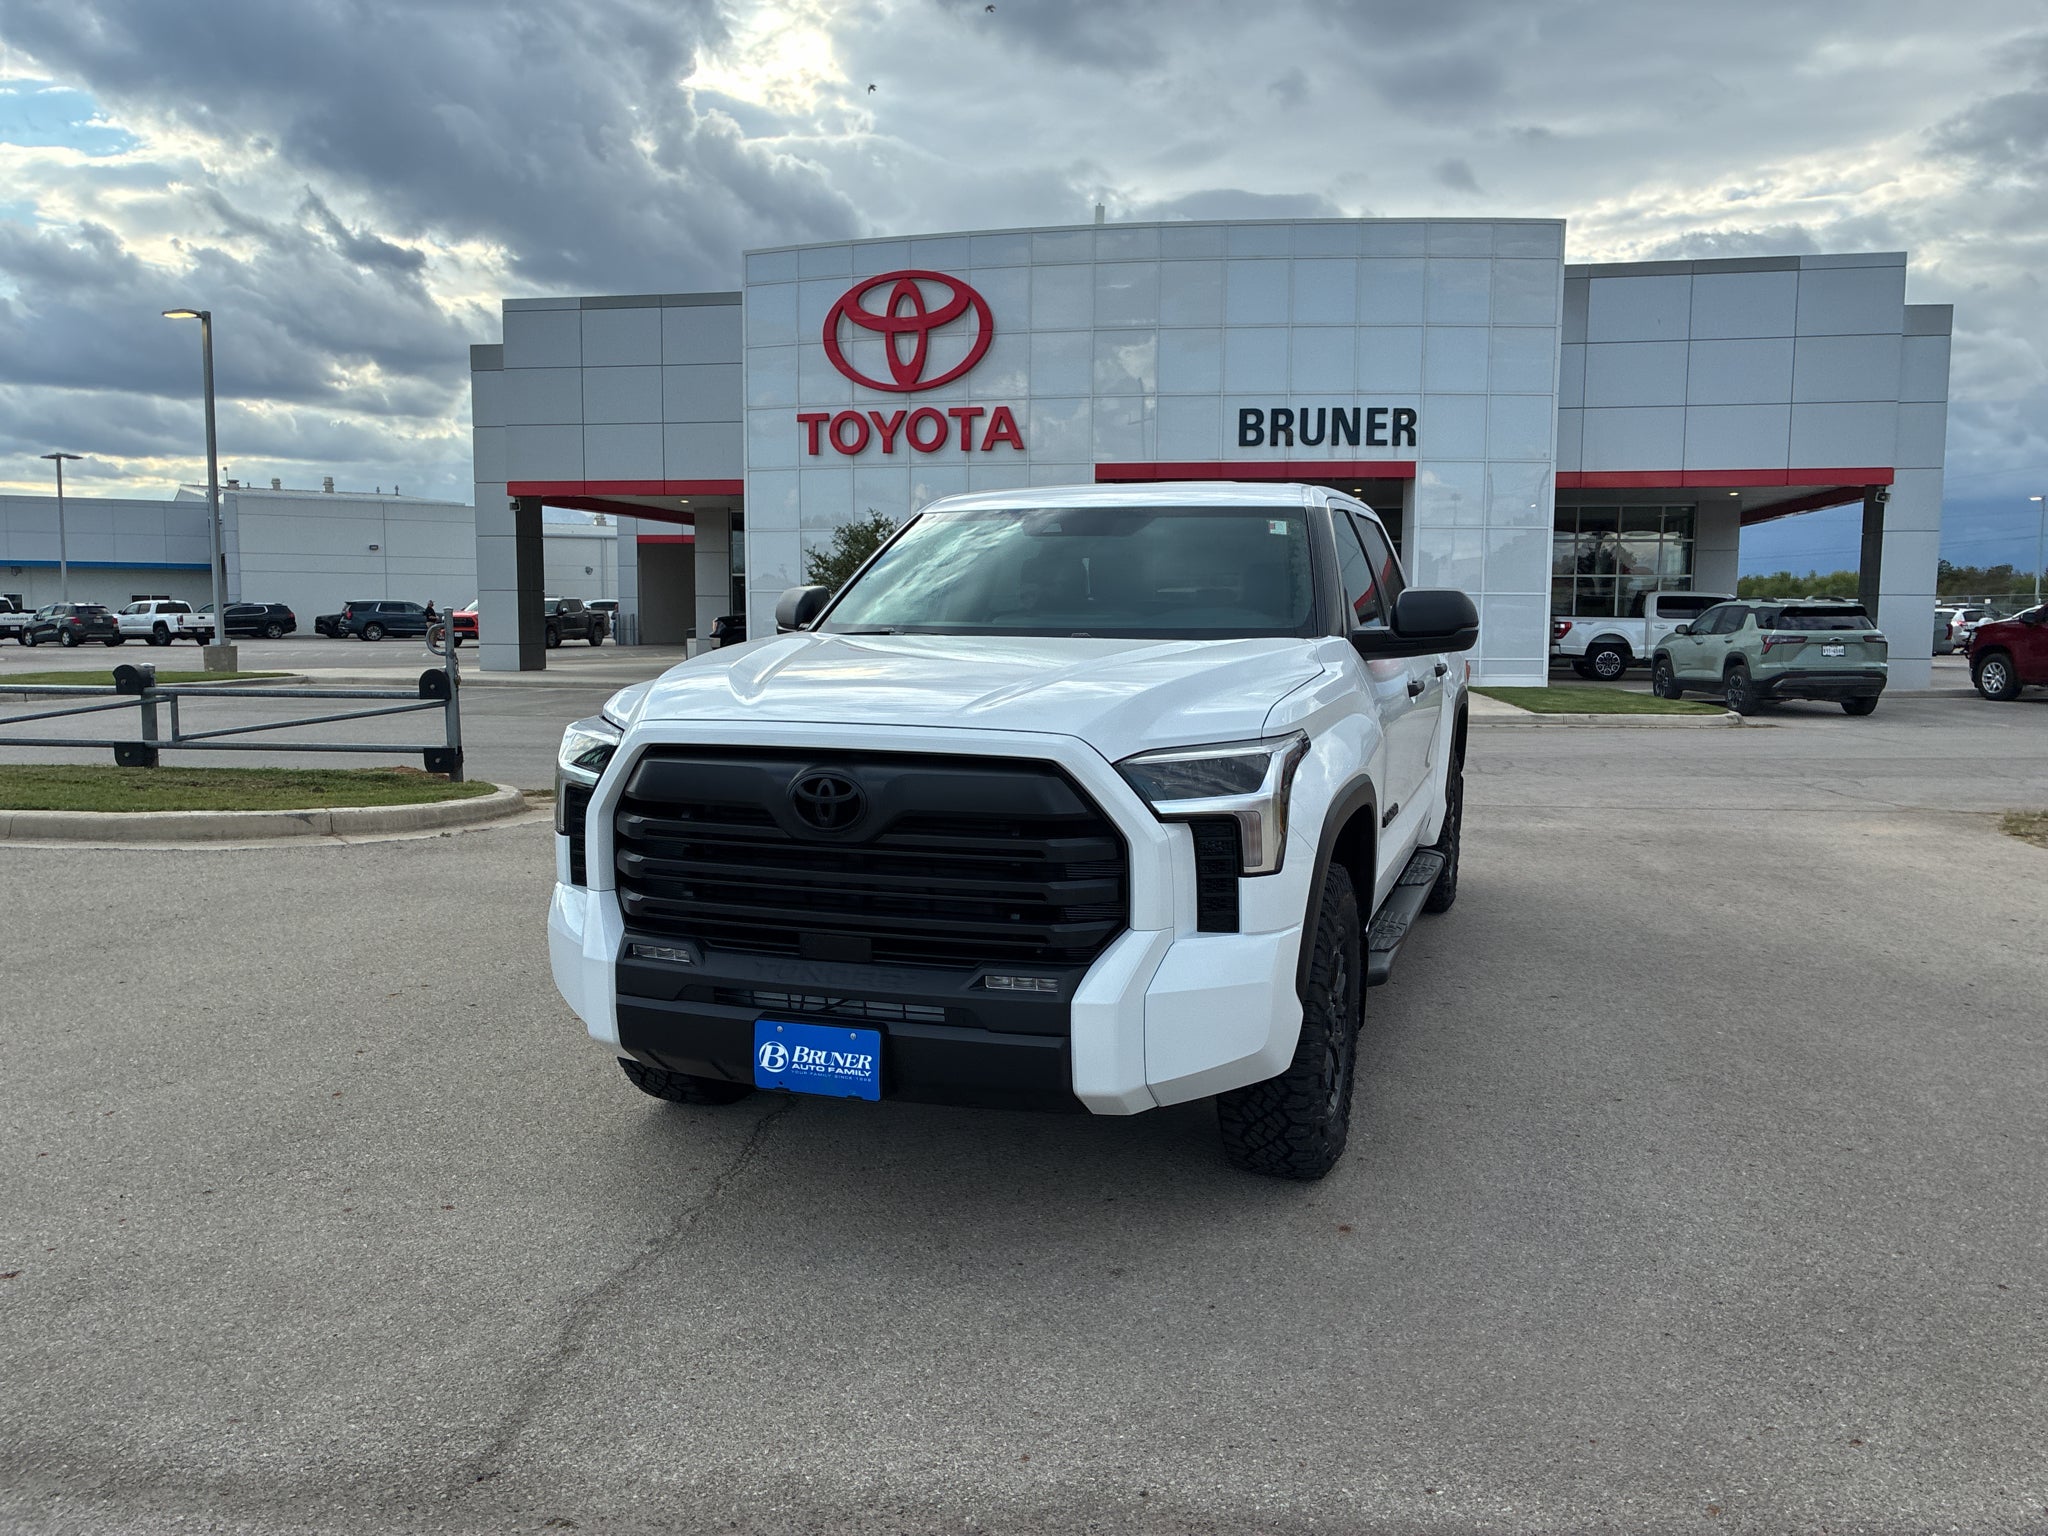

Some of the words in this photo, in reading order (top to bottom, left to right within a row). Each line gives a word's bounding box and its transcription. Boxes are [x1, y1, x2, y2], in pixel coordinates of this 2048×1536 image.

[797, 406, 1024, 455] TOYOTA
[1238, 407, 1417, 447] BRUNER
[792, 1045, 872, 1070] BRUNER
[792, 1063, 825, 1072] AUTO
[828, 1067, 872, 1077] FAMILY
